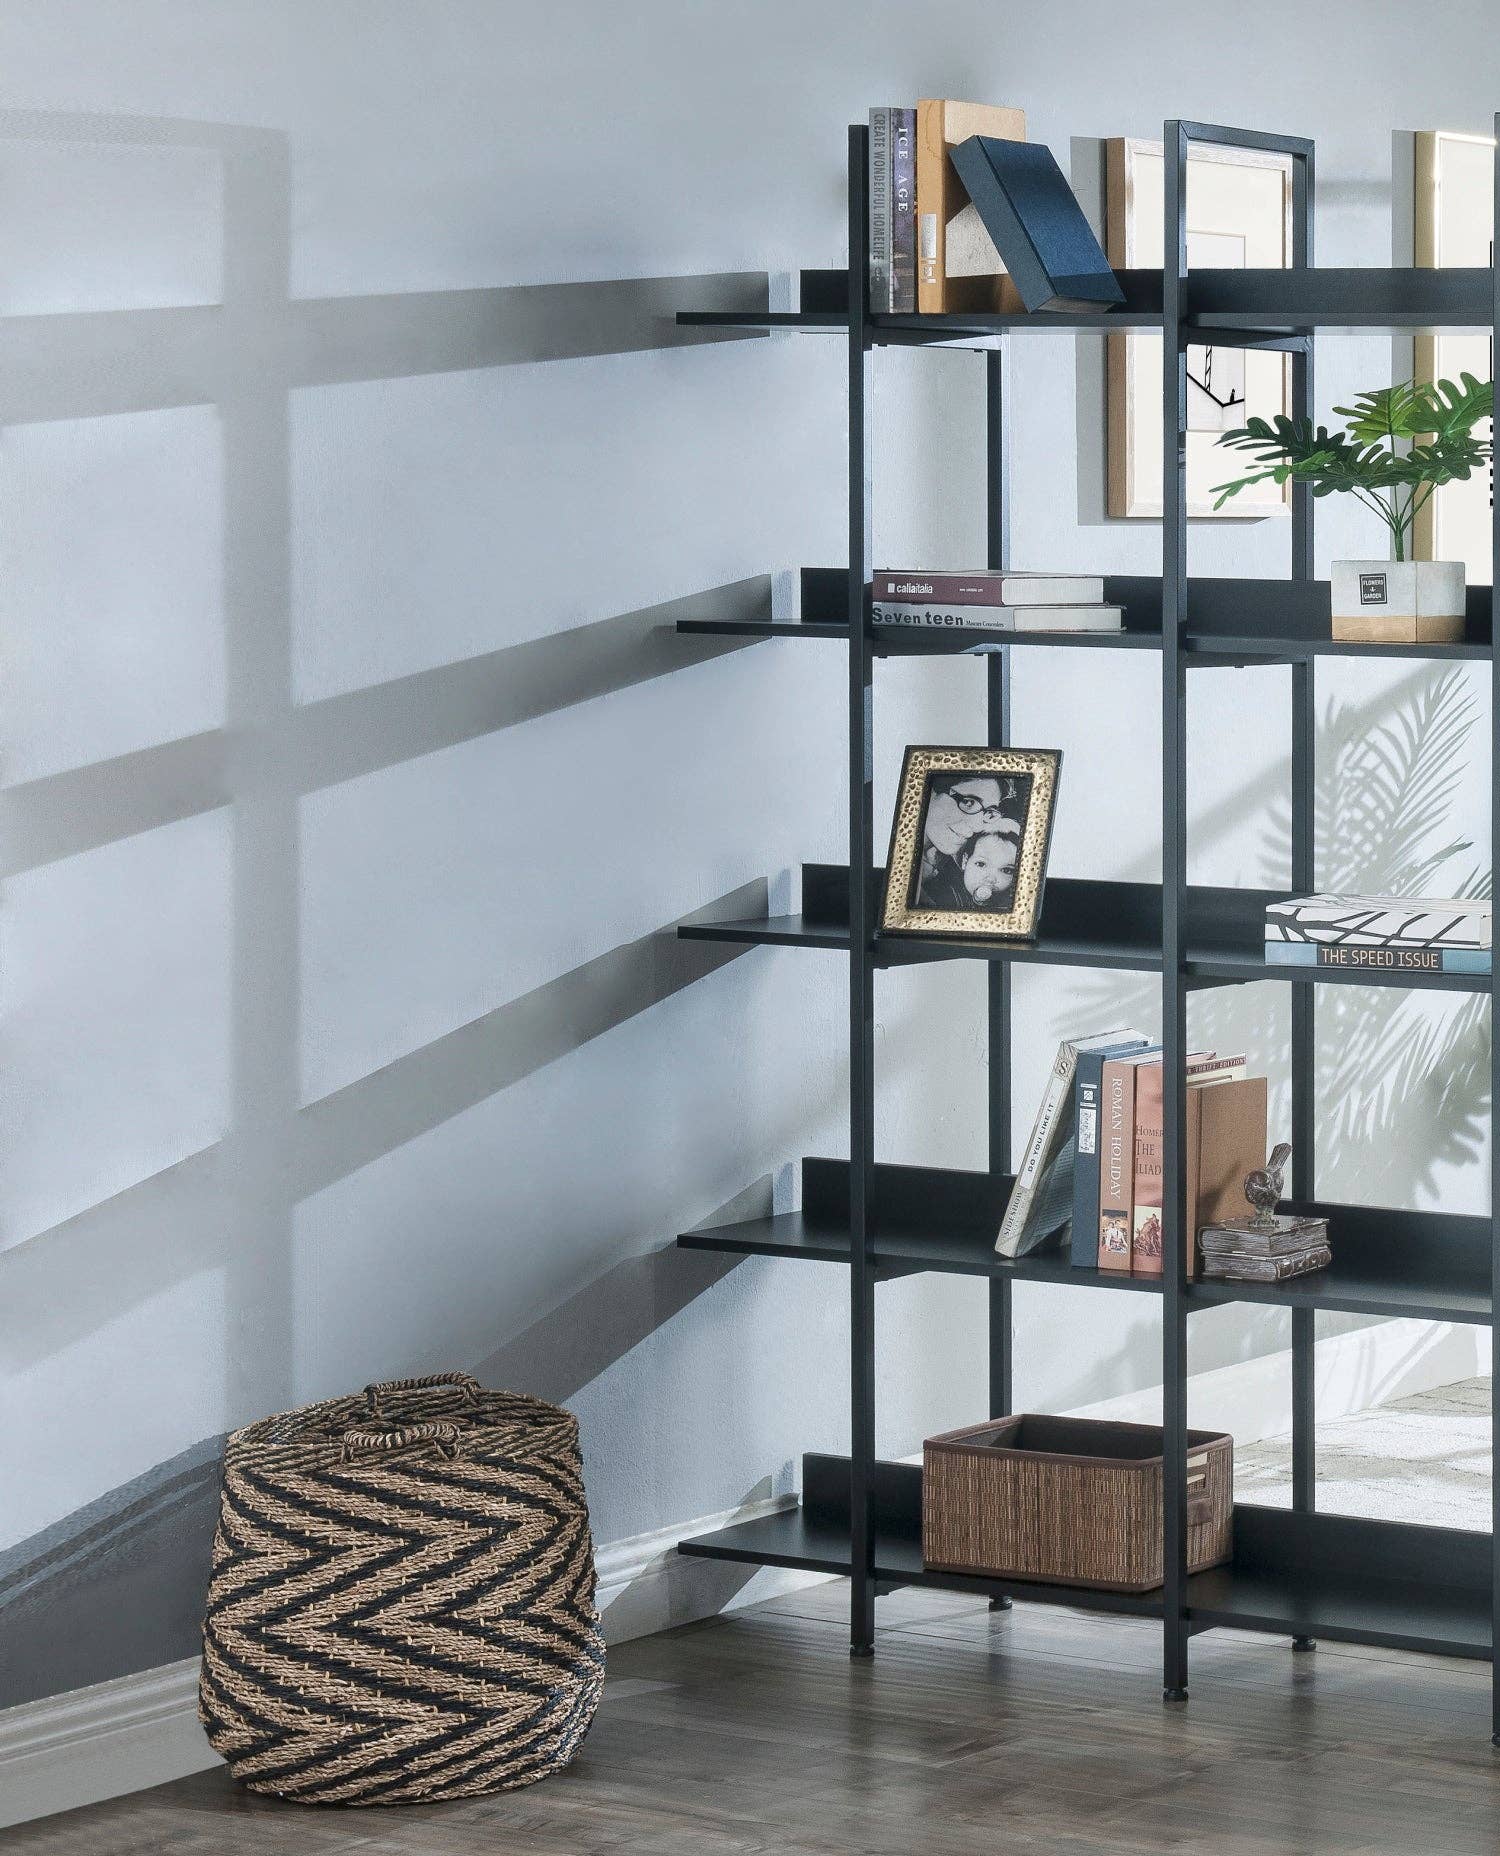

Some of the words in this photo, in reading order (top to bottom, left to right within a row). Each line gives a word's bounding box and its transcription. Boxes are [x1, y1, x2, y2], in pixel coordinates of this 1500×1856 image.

[873, 113, 886, 147] CREATE
[898, 128, 909, 159] ICE
[873, 151, 886, 210] WONDERFUL
[898, 175, 909, 211] AGE
[873, 213, 885, 260] HOMELIFE
[1321, 948, 1348, 964] THE
[1351, 950, 1394, 966] SPEED
[1397, 952, 1439, 968] ISSUE
[1111, 1078, 1123, 1130] ROMAN
[1028, 1159, 1036, 1172] DO
[1034, 1137, 1043, 1155] YOU
[1040, 1115, 1051, 1135] LIKE
[1047, 1103, 1055, 1112] IT
[1135, 1139, 1155, 1156] THE
[1110, 1137, 1122, 1200] HOLIDAY
[1135, 1158, 1162, 1176] ILIAD
